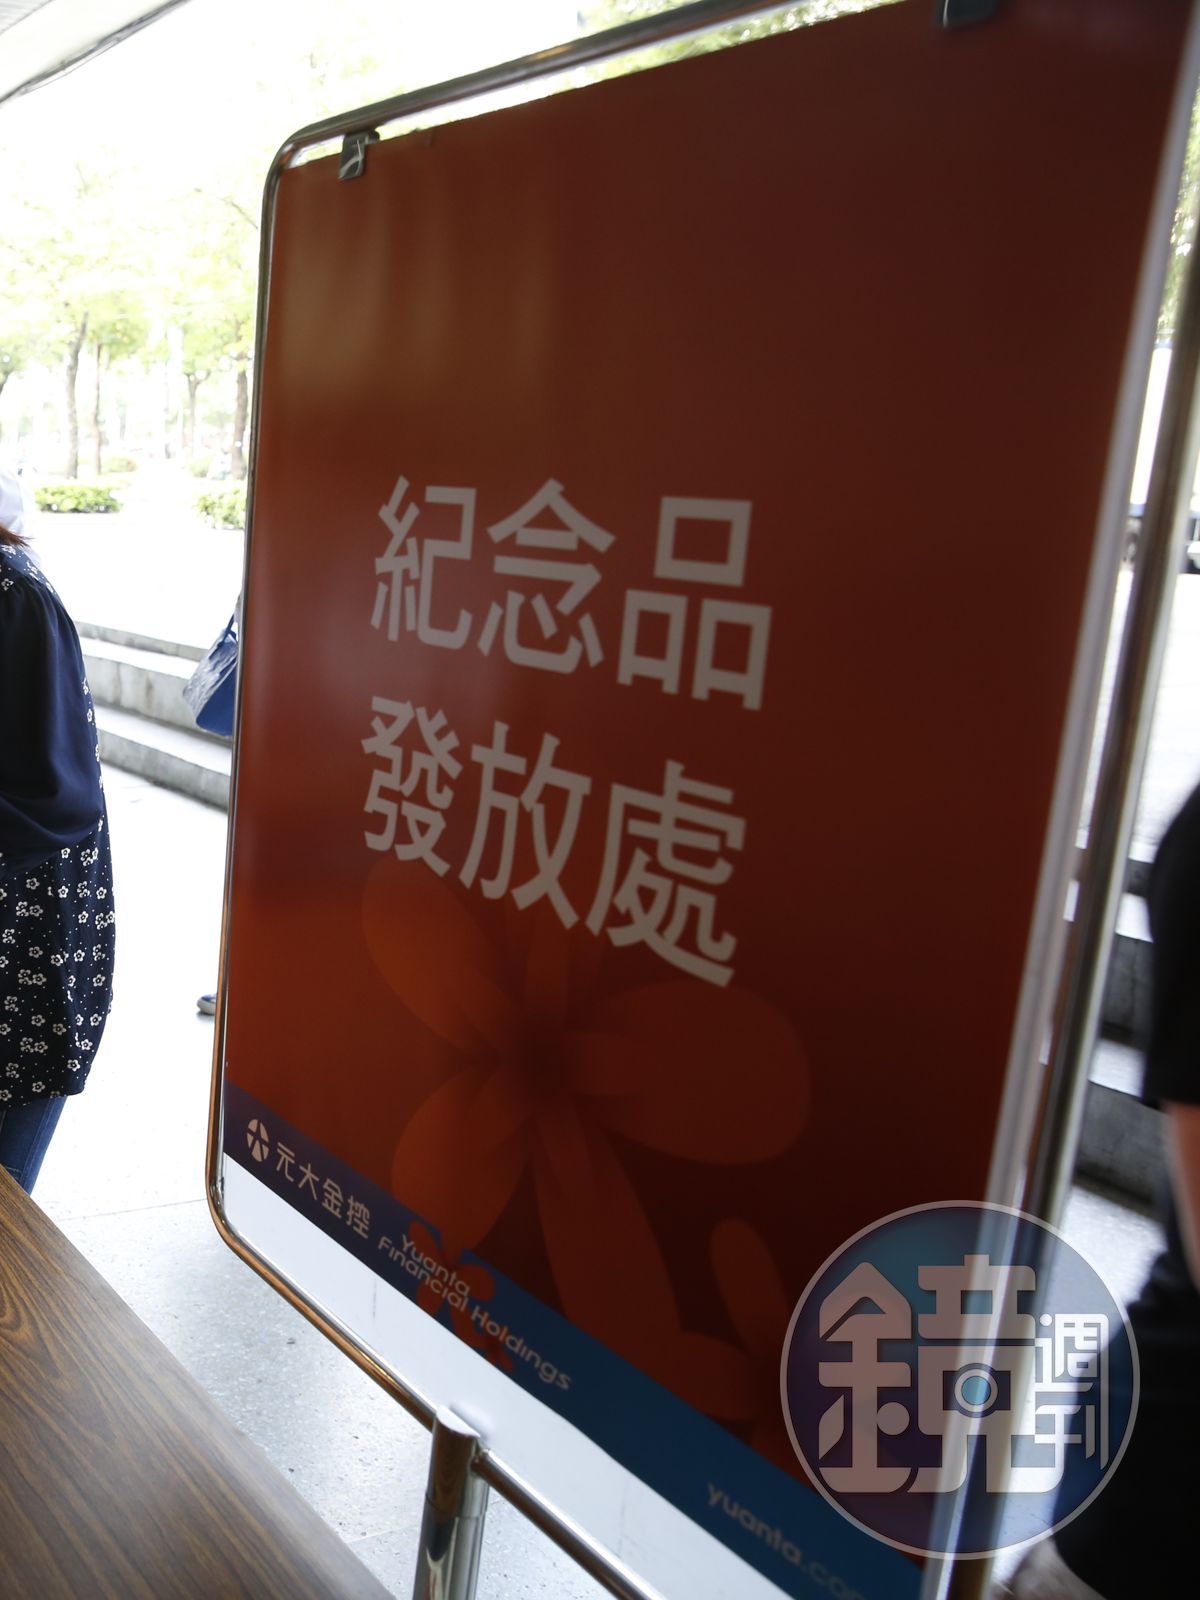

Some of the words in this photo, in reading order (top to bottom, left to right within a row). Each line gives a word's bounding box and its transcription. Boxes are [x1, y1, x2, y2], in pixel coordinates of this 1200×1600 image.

[371, 475, 772, 711] 紀念品
[361, 696, 747, 988] 發放處
[275, 1141, 371, 1239] 元大金控
[401, 1234, 471, 1297] Yuanta
[378, 1236, 468, 1312] Financial
[472, 1306, 572, 1392] Holdings
